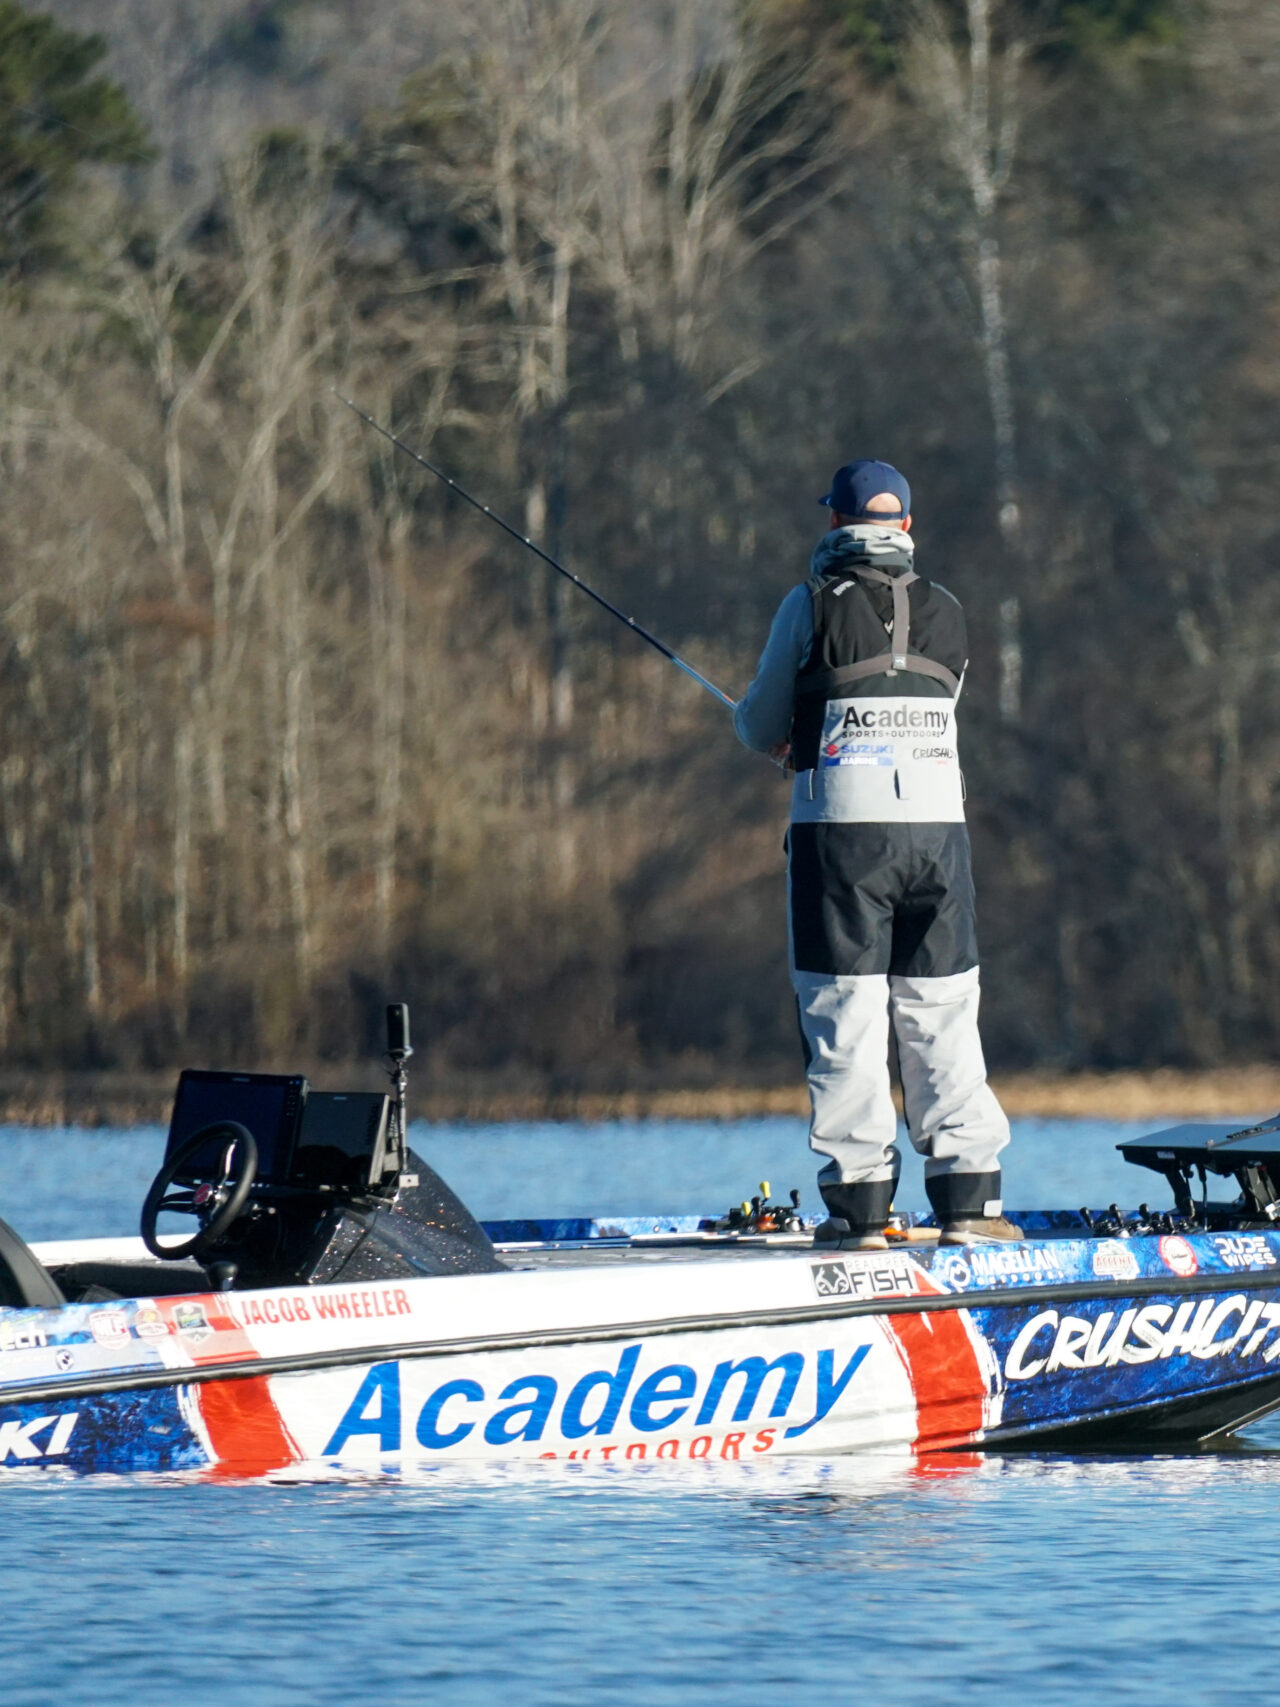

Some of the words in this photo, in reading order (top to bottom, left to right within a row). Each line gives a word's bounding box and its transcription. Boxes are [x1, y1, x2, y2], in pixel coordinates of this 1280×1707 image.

[842, 704, 949, 735] Academy
[839, 757, 878, 766] MARINE
[841, 744, 894, 755] SUZUKI
[1214, 1236, 1271, 1255] DUDE
[970, 1248, 1060, 1276] MAGELLAN
[1222, 1251, 1277, 1268] WIPES
[850, 1267, 914, 1294] FISH
[240, 1297, 310, 1326] JACOB
[311, 1288, 412, 1319] WHEELER
[322, 1343, 873, 1456] Academy
